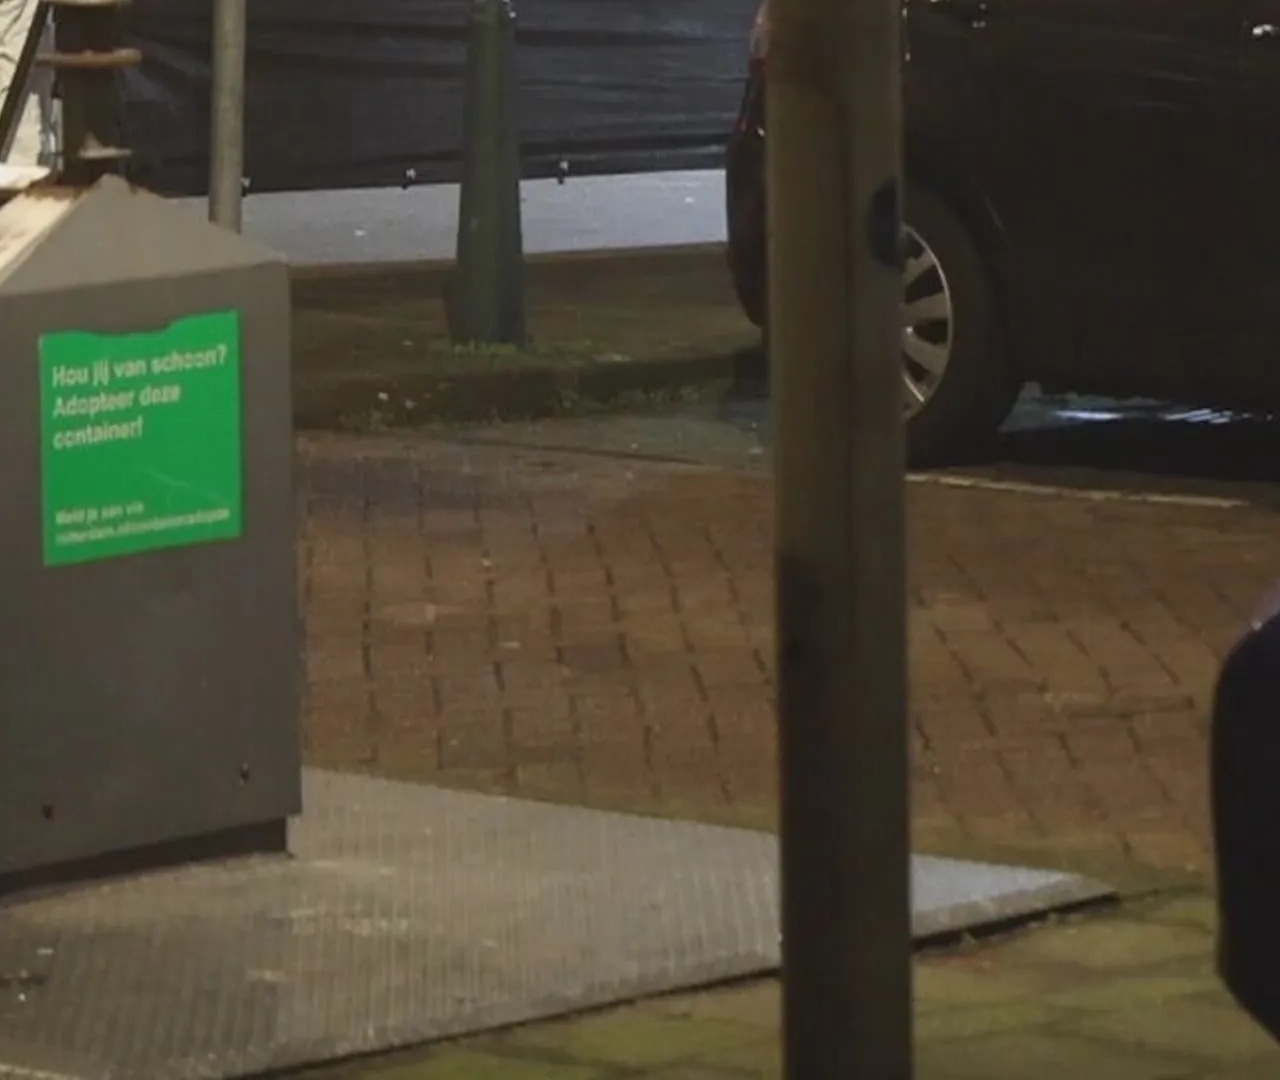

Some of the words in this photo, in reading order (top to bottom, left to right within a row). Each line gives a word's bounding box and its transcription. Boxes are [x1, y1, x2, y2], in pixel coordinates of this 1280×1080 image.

[51, 363, 90, 388] Hou
[92, 359, 109, 387] jij
[112, 358, 147, 378] van
[150, 342, 228, 376] schoon?
[51, 389, 136, 420] Adopteer
[138, 383, 182, 407] deze
[51, 415, 144, 451] container!
